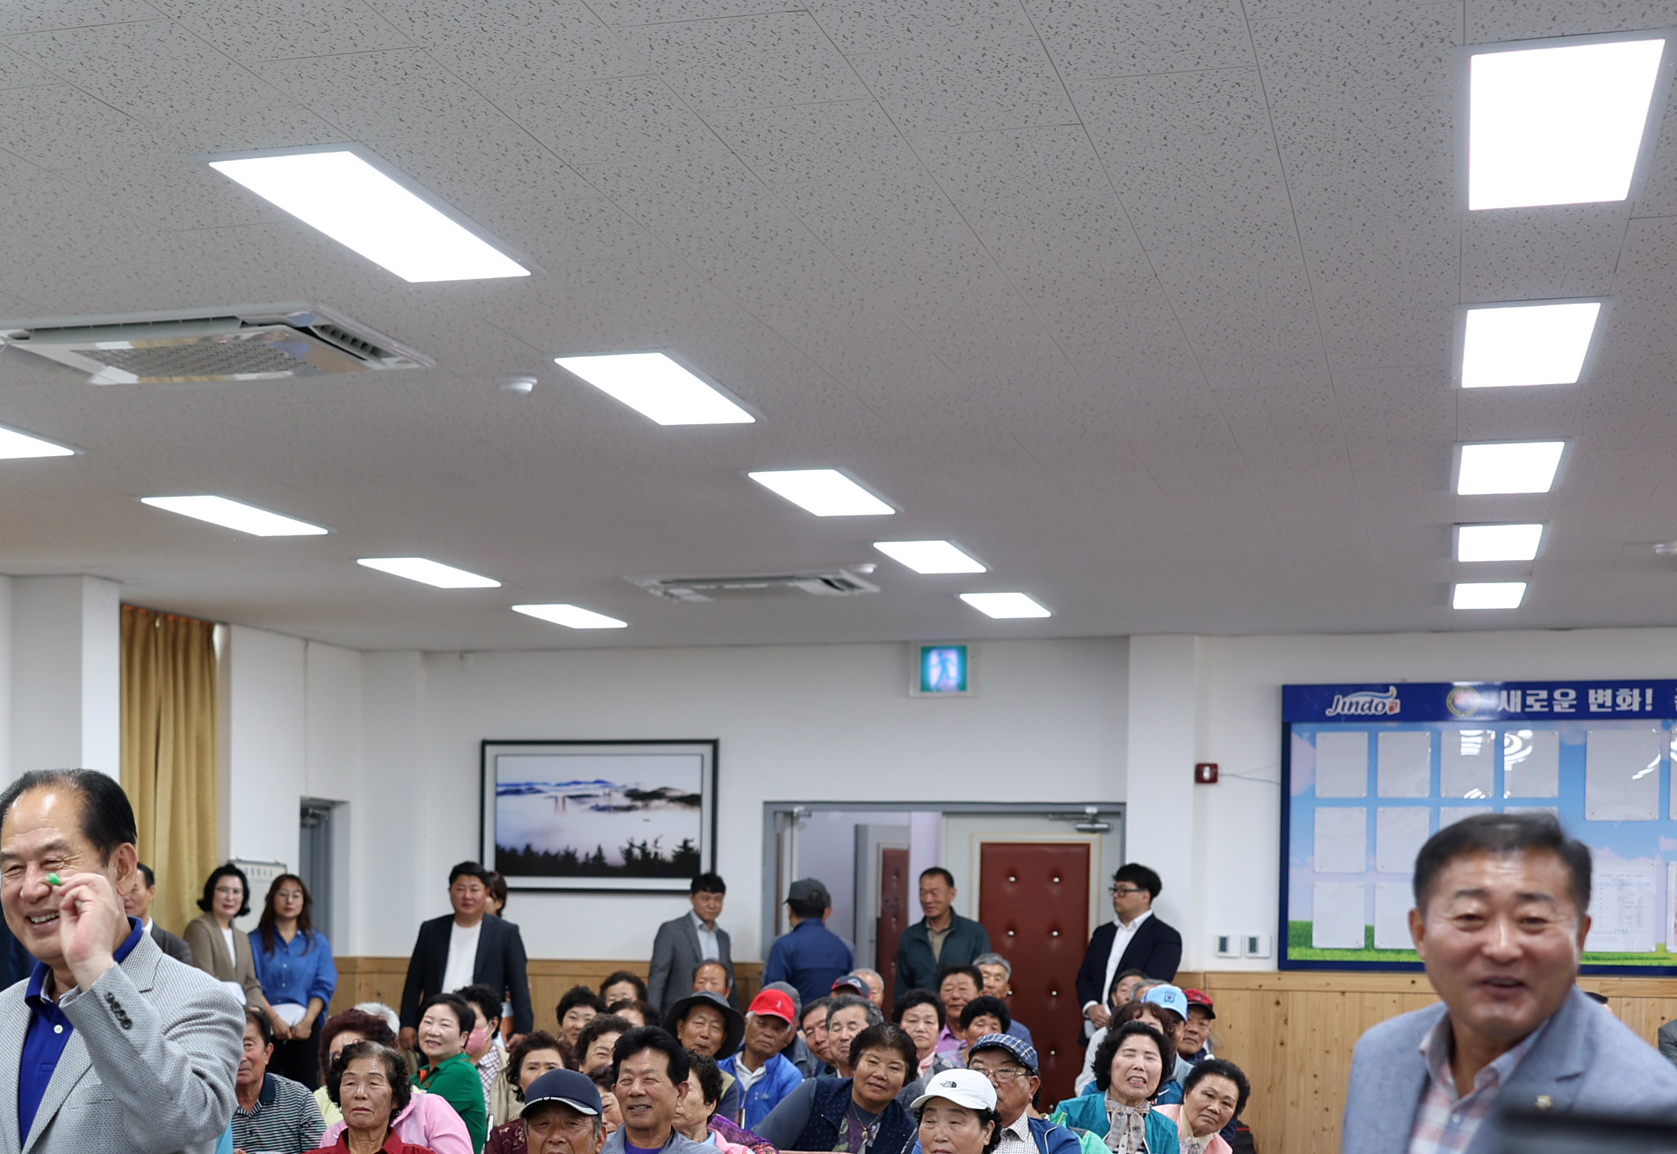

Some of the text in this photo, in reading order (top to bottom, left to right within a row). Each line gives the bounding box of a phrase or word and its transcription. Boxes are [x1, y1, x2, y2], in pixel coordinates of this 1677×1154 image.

[1325, 694, 1387, 716] Jindo
[1497, 688, 1577, 713] 새로운
[1588, 688, 1653, 713] 변화!
